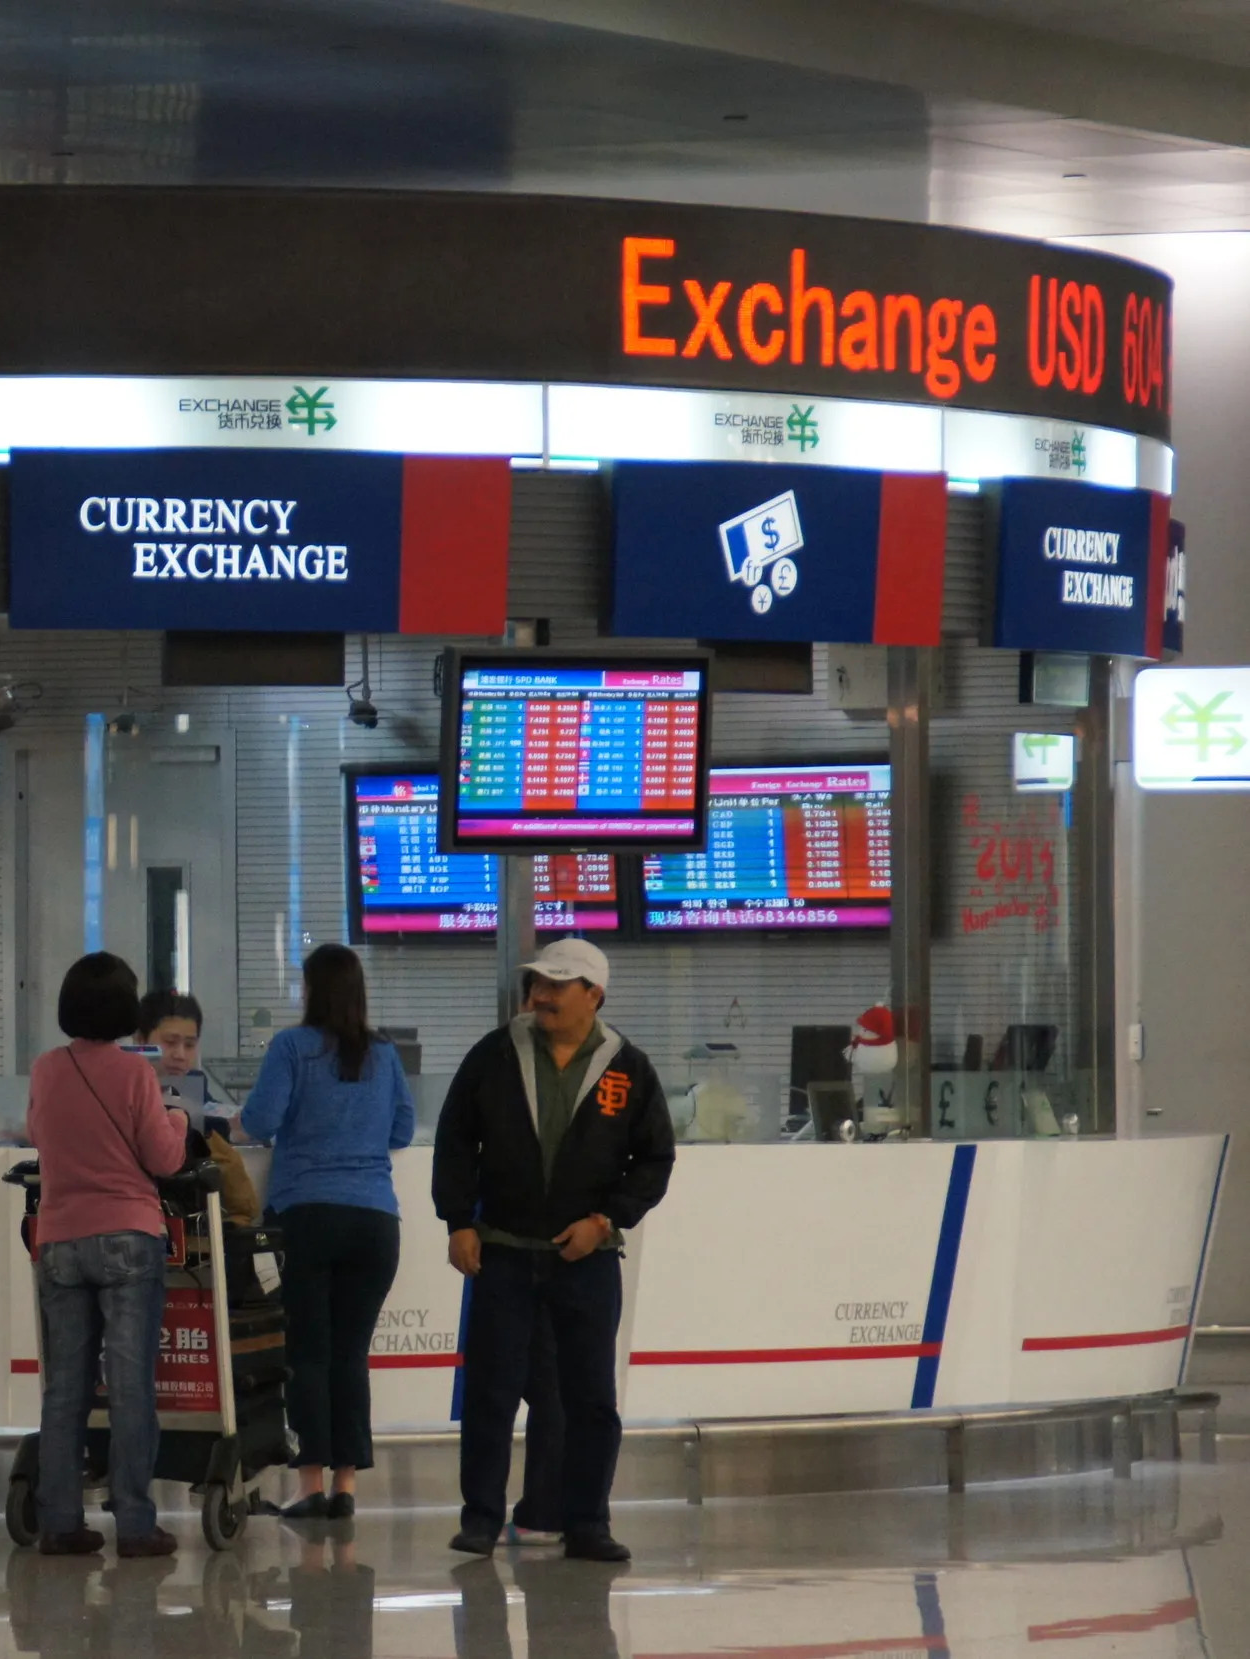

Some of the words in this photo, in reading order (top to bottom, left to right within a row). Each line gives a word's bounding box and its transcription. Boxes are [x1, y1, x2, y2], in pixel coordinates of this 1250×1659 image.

[621, 236, 997, 400] Exchange
[1028, 274, 1104, 394] USD
[179, 398, 282, 412] EXCHANGE
[217, 412, 282, 430] 货币兑换
[714, 413, 784, 428] EXCHANGE
[741, 428, 785, 446] 货币兑换
[79, 496, 297, 535] CURRENCY
[1044, 526, 1121, 564] CURRENCY
[132, 542, 349, 580] EXCHANGE
[1062, 569, 1134, 608] EXCHANGE
[652, 675, 682, 685] Rates
[826, 776, 867, 787] Rates
[375, 1308, 430, 1328] ENCY
[834, 1301, 909, 1321] CURRENCY
[370, 1331, 456, 1352] CHANGE
[849, 1323, 923, 1344] EXCHANGE
[160, 1353, 210, 1364] TIRES
